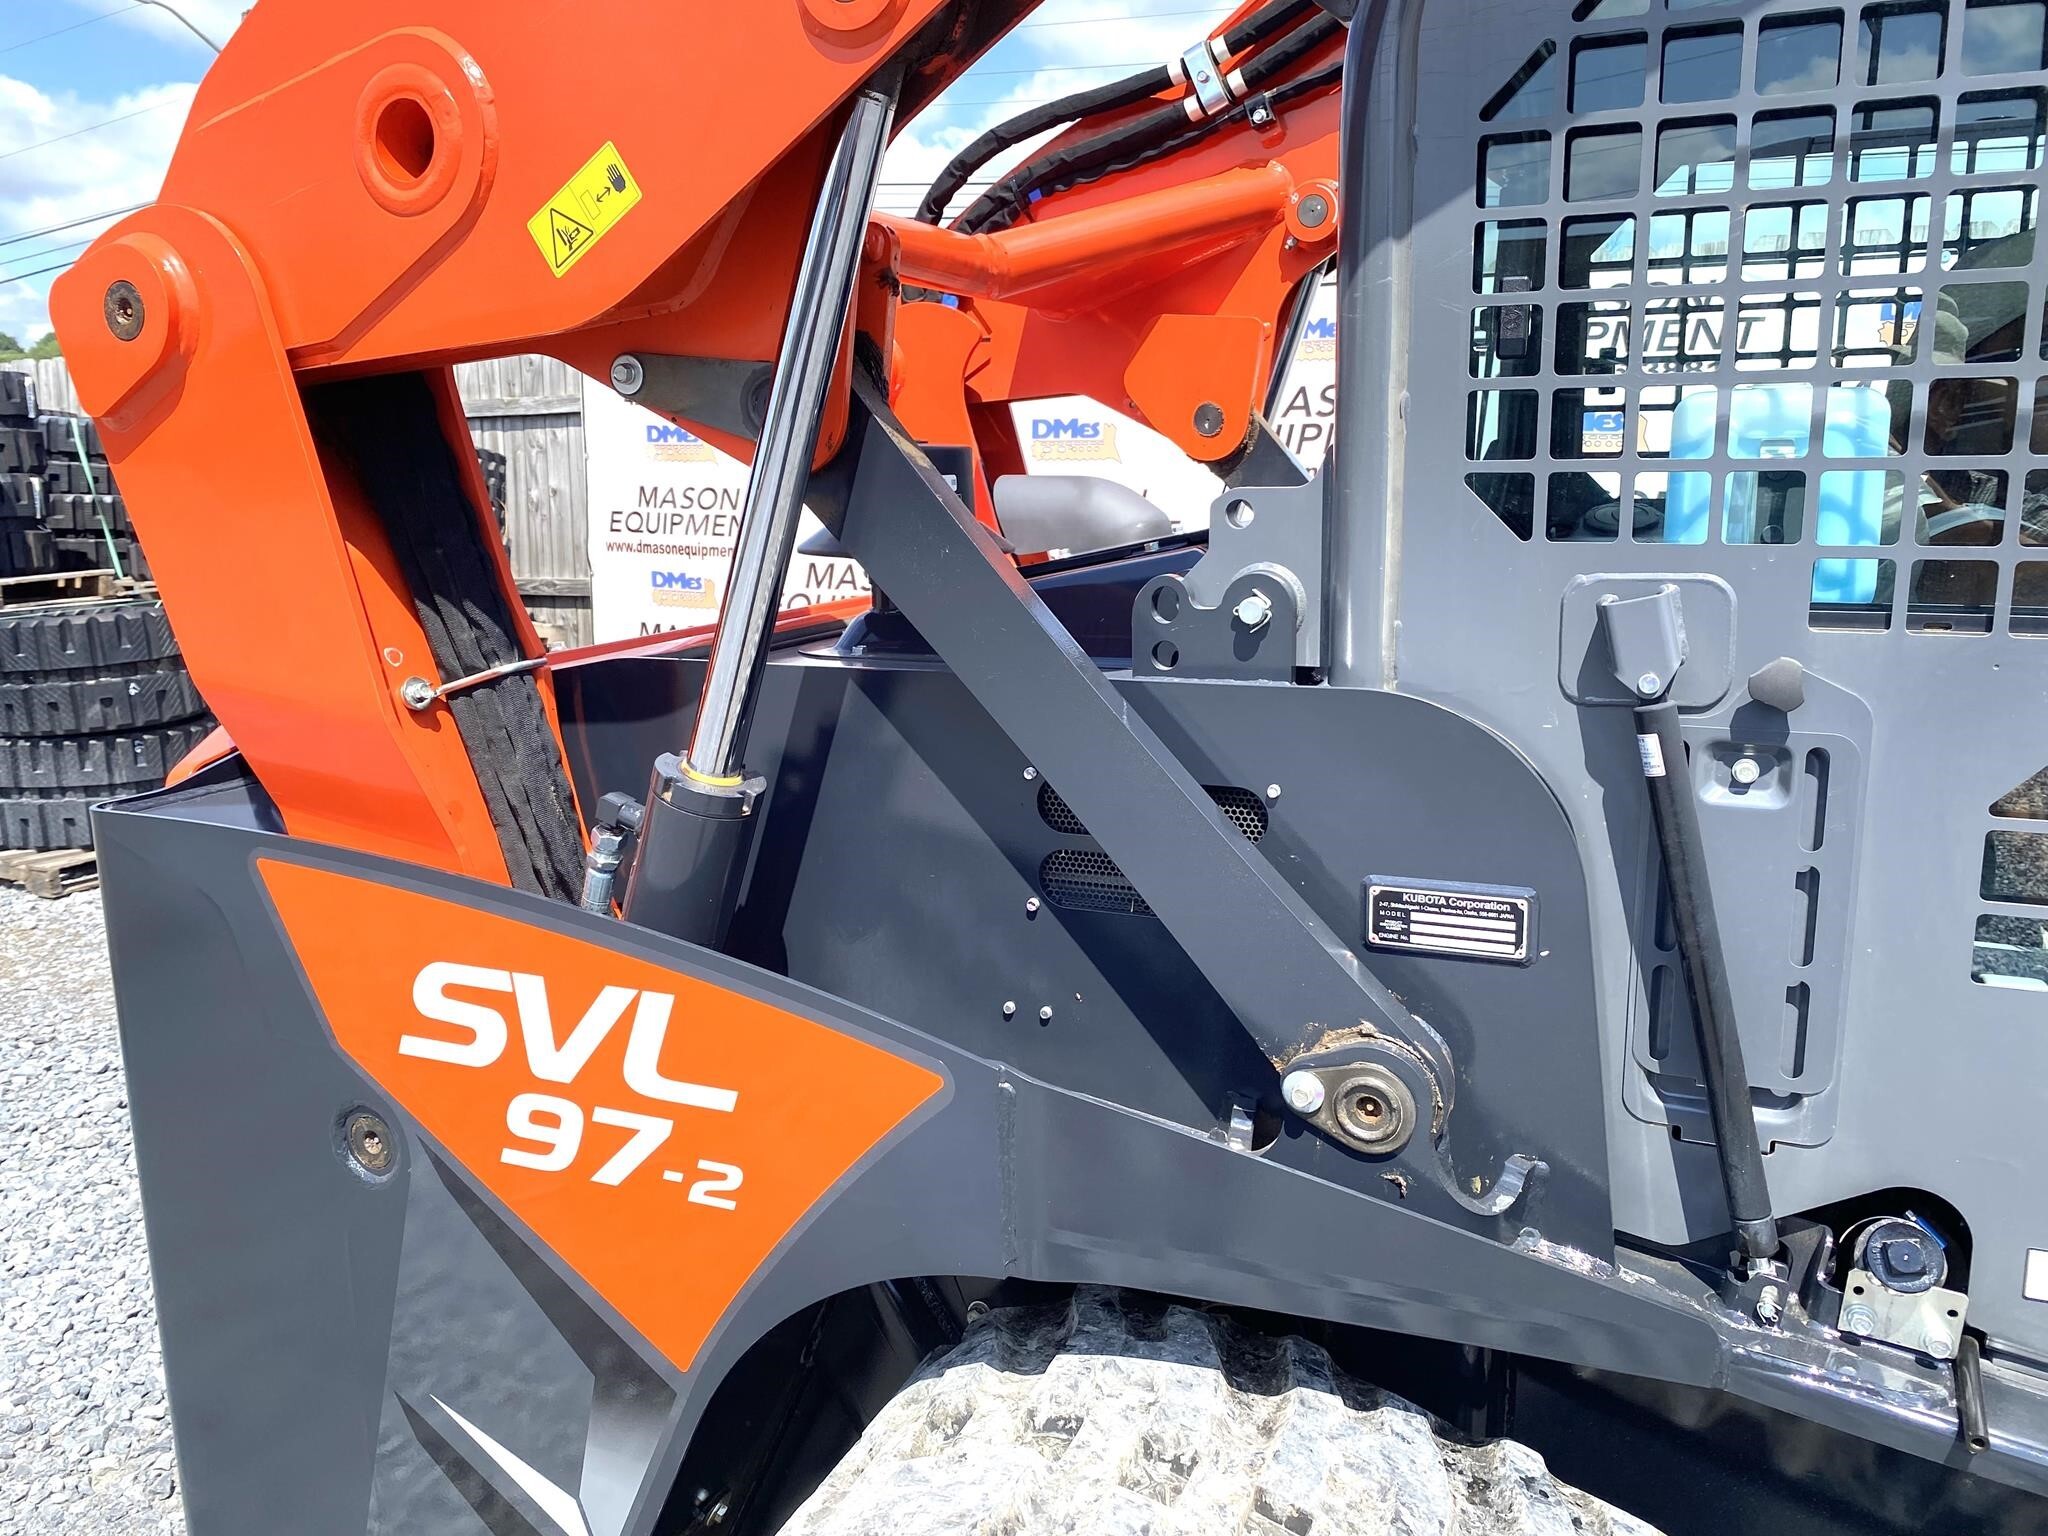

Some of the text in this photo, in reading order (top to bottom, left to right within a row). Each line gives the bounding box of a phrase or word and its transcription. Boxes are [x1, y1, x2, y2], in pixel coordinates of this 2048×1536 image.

[637, 486, 741, 511] MASON
[1402, 893, 1447, 906] KUBOTA
[1448, 898, 1511, 912] Corporation
[1379, 910, 1406, 918] MODEL
[398, 961, 739, 1113] SVL
